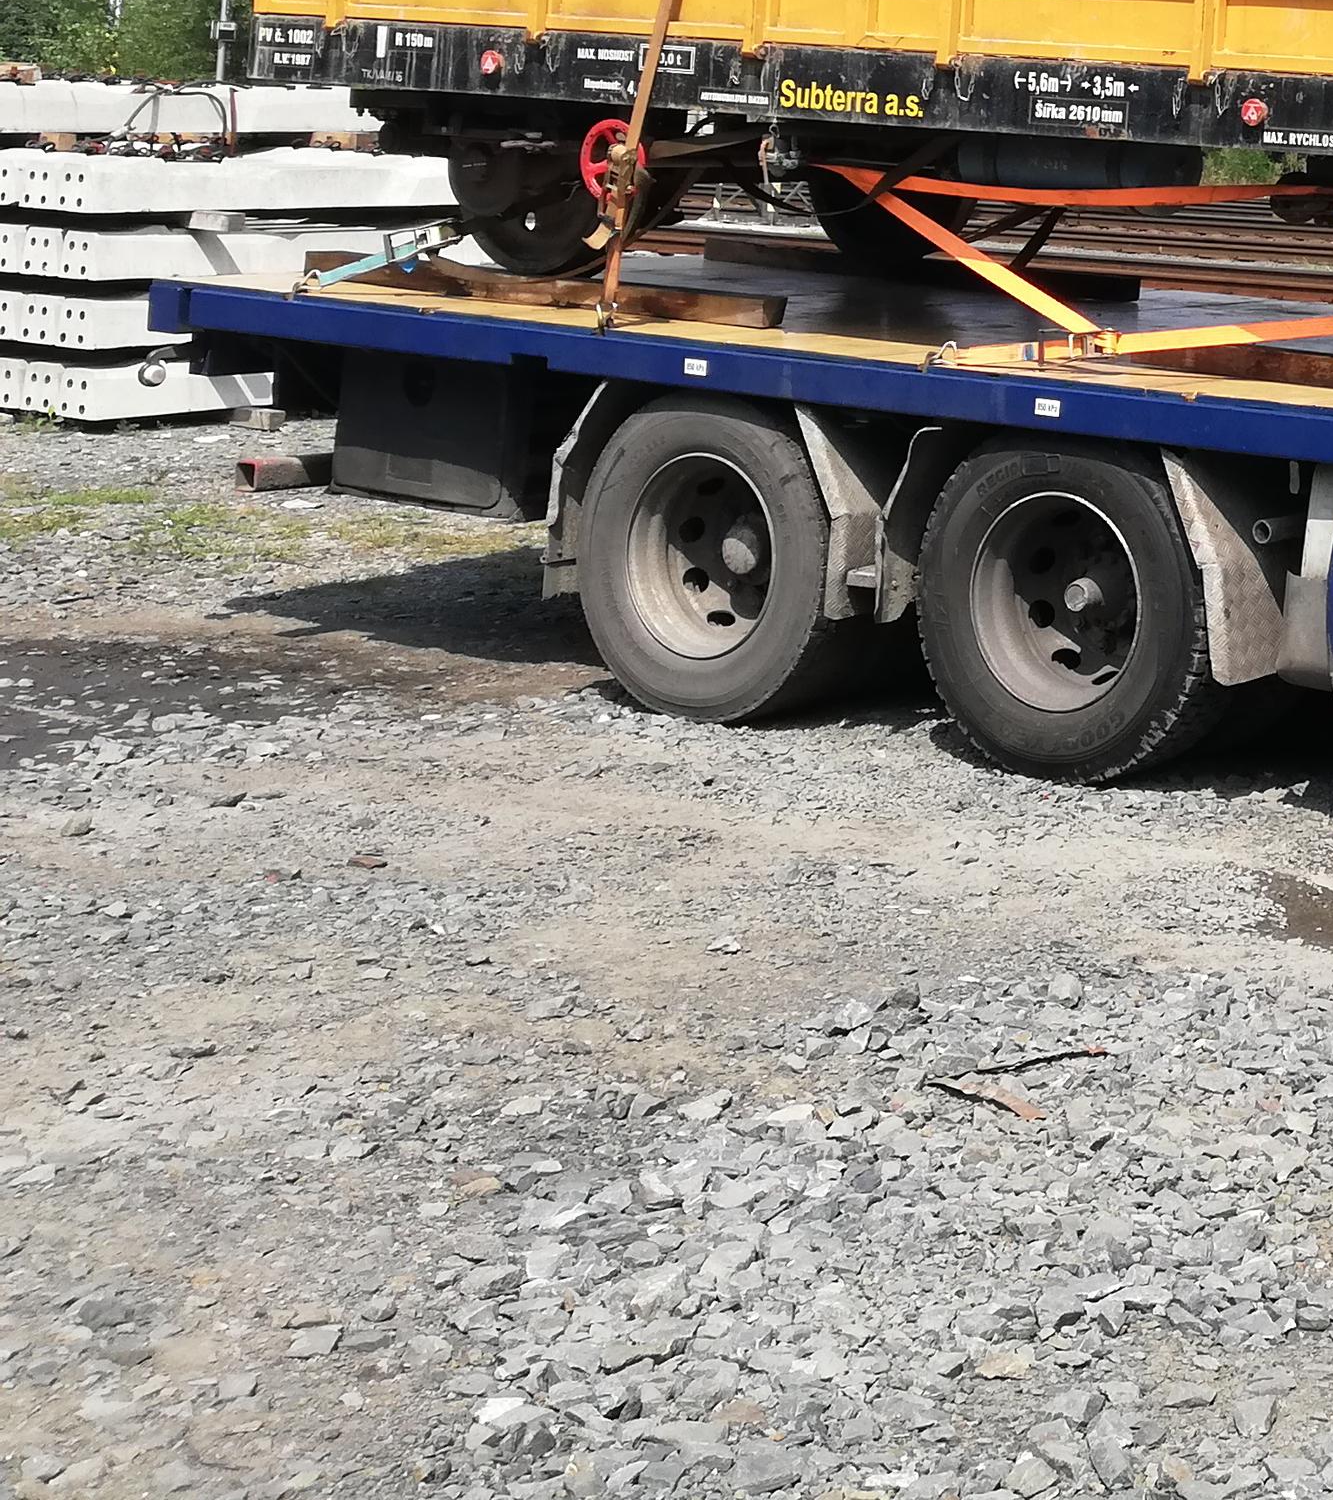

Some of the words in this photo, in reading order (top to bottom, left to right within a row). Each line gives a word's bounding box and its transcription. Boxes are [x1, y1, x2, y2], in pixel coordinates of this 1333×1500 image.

[258, 26, 273, 42] PV
[287, 28, 314, 45] 1002
[780, 78, 879, 114] Subterra
[884, 93, 924, 118] a.s.
[1034, 99, 1066, 120] Šířka
[1262, 130, 1288, 145] MAX.
